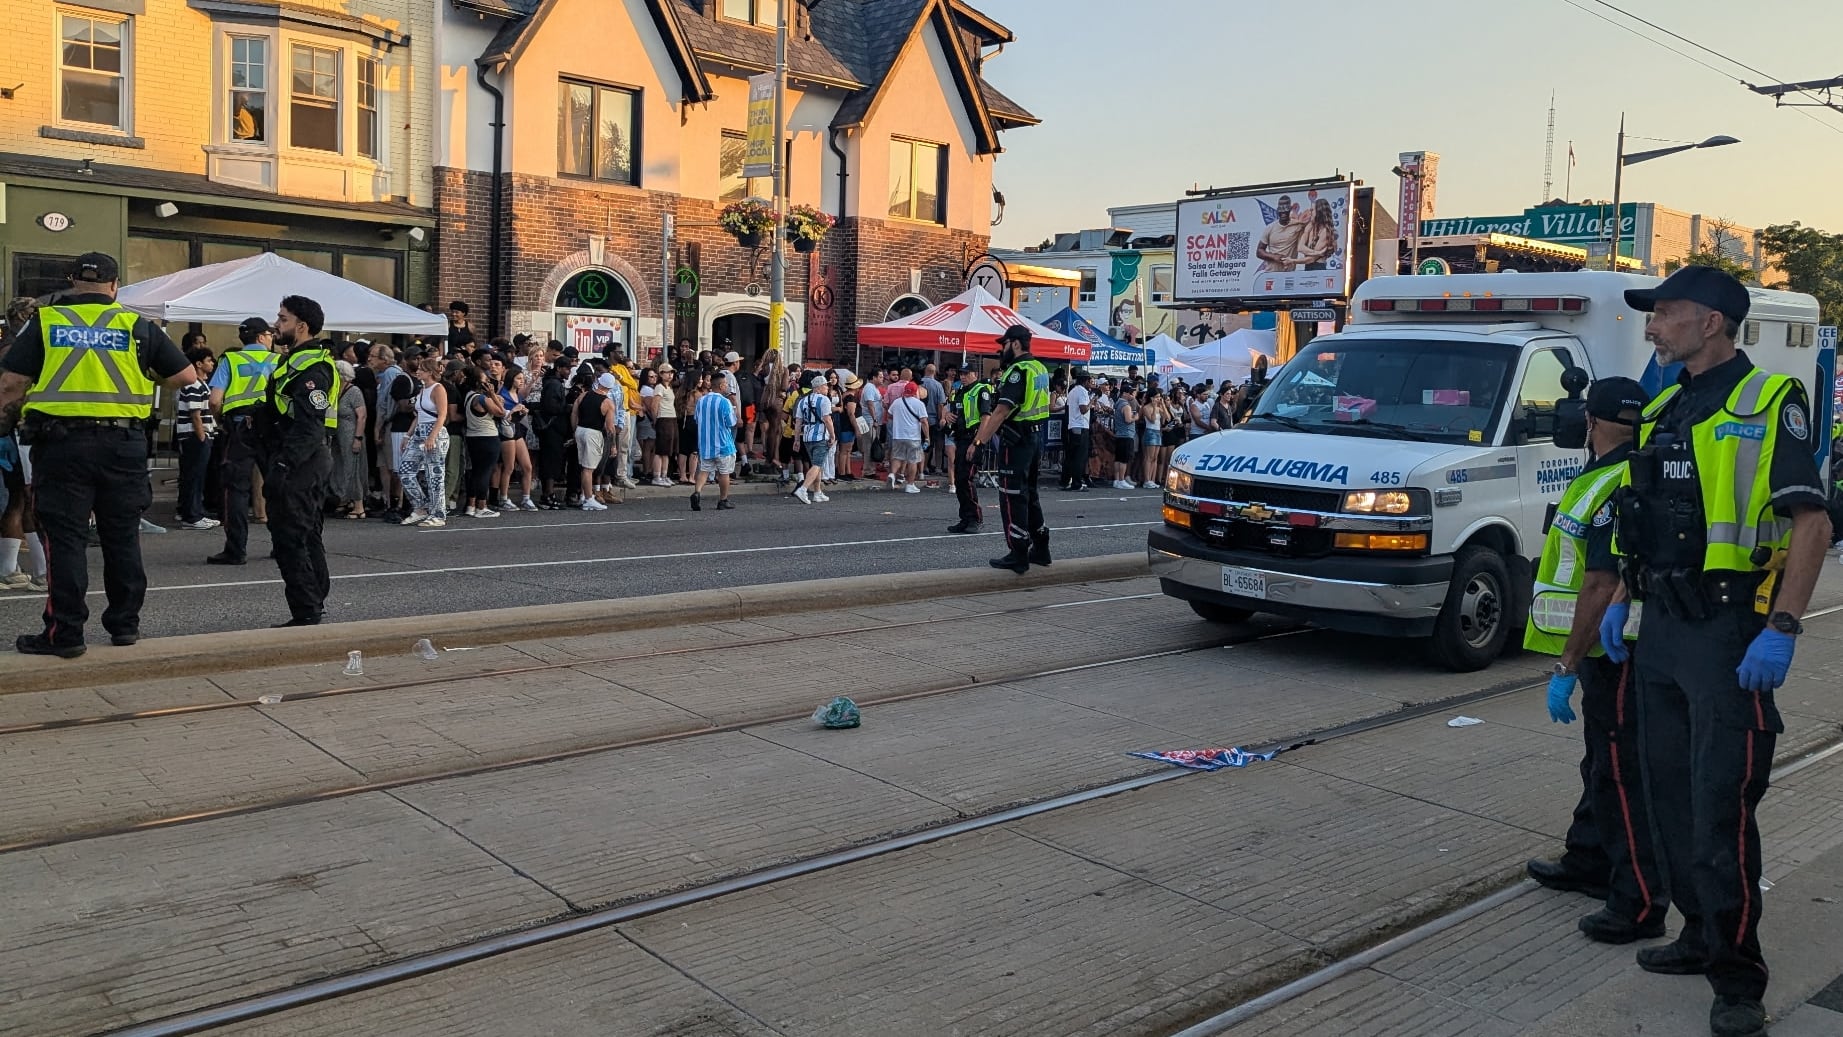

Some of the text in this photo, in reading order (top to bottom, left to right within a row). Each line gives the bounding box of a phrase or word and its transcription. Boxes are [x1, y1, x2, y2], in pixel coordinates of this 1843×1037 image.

[749, 116, 772, 127] LOCAL
[747, 147, 771, 157] LOCAL
[48, 216, 65, 227] 779
[1201, 210, 1236, 225] SALSA
[1429, 211, 1635, 237] Hillcrest Village
[1186, 233, 1228, 250] SCAN
[1187, 249, 1227, 262] TO WIN
[1188, 260, 1247, 270] Salsa at Niagara
[1192, 269, 1241, 278] Falls Getaway
[585, 280, 601, 299] K
[1292, 311, 1332, 320] PATTISON
[55, 328, 125, 349] POLICE
[576, 331, 591, 353] tln
[596, 335, 611, 344] VIP
[939, 334, 960, 345] tln.ca
[1063, 344, 1086, 356] tln.ca
[1621, 399, 1642, 407] POLICE
[1174, 454, 1191, 466] 485
[1541, 456, 1579, 469] TORONTO
[1450, 469, 1468, 484] 485
[1536, 465, 1583, 485] PARAMEDIC
[1663, 461, 1695, 479] POLIC
[1370, 471, 1401, 485] 485
[1553, 513, 1587, 537] OLICE
[1223, 573, 1234, 588] BL
[1238, 575, 1264, 592] 65684
